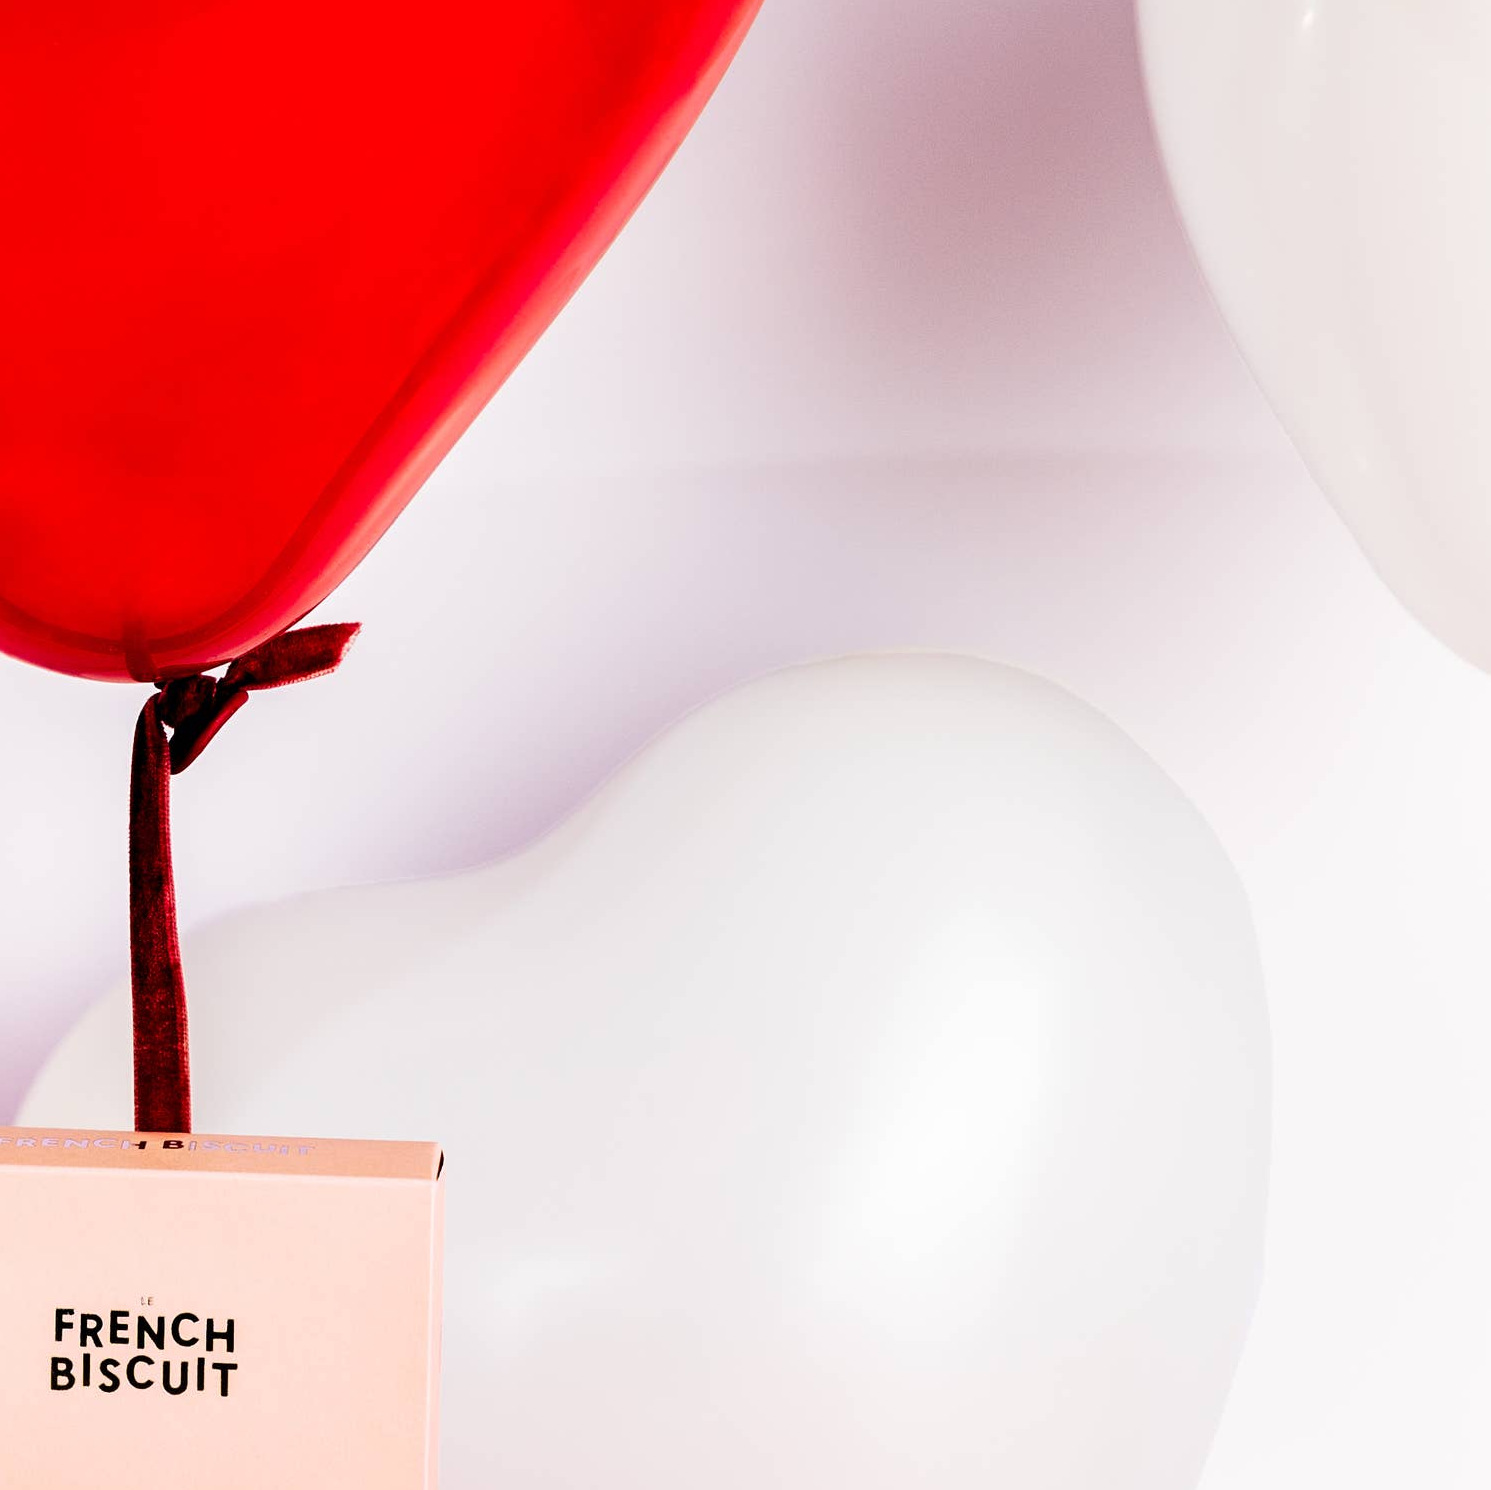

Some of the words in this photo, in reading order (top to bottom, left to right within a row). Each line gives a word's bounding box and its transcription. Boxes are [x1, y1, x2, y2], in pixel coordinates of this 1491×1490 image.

[162, 1139, 316, 1156] BISCUIT
[54, 1308, 235, 1353] FRENCH
[50, 1352, 238, 1397] BISCUIT
